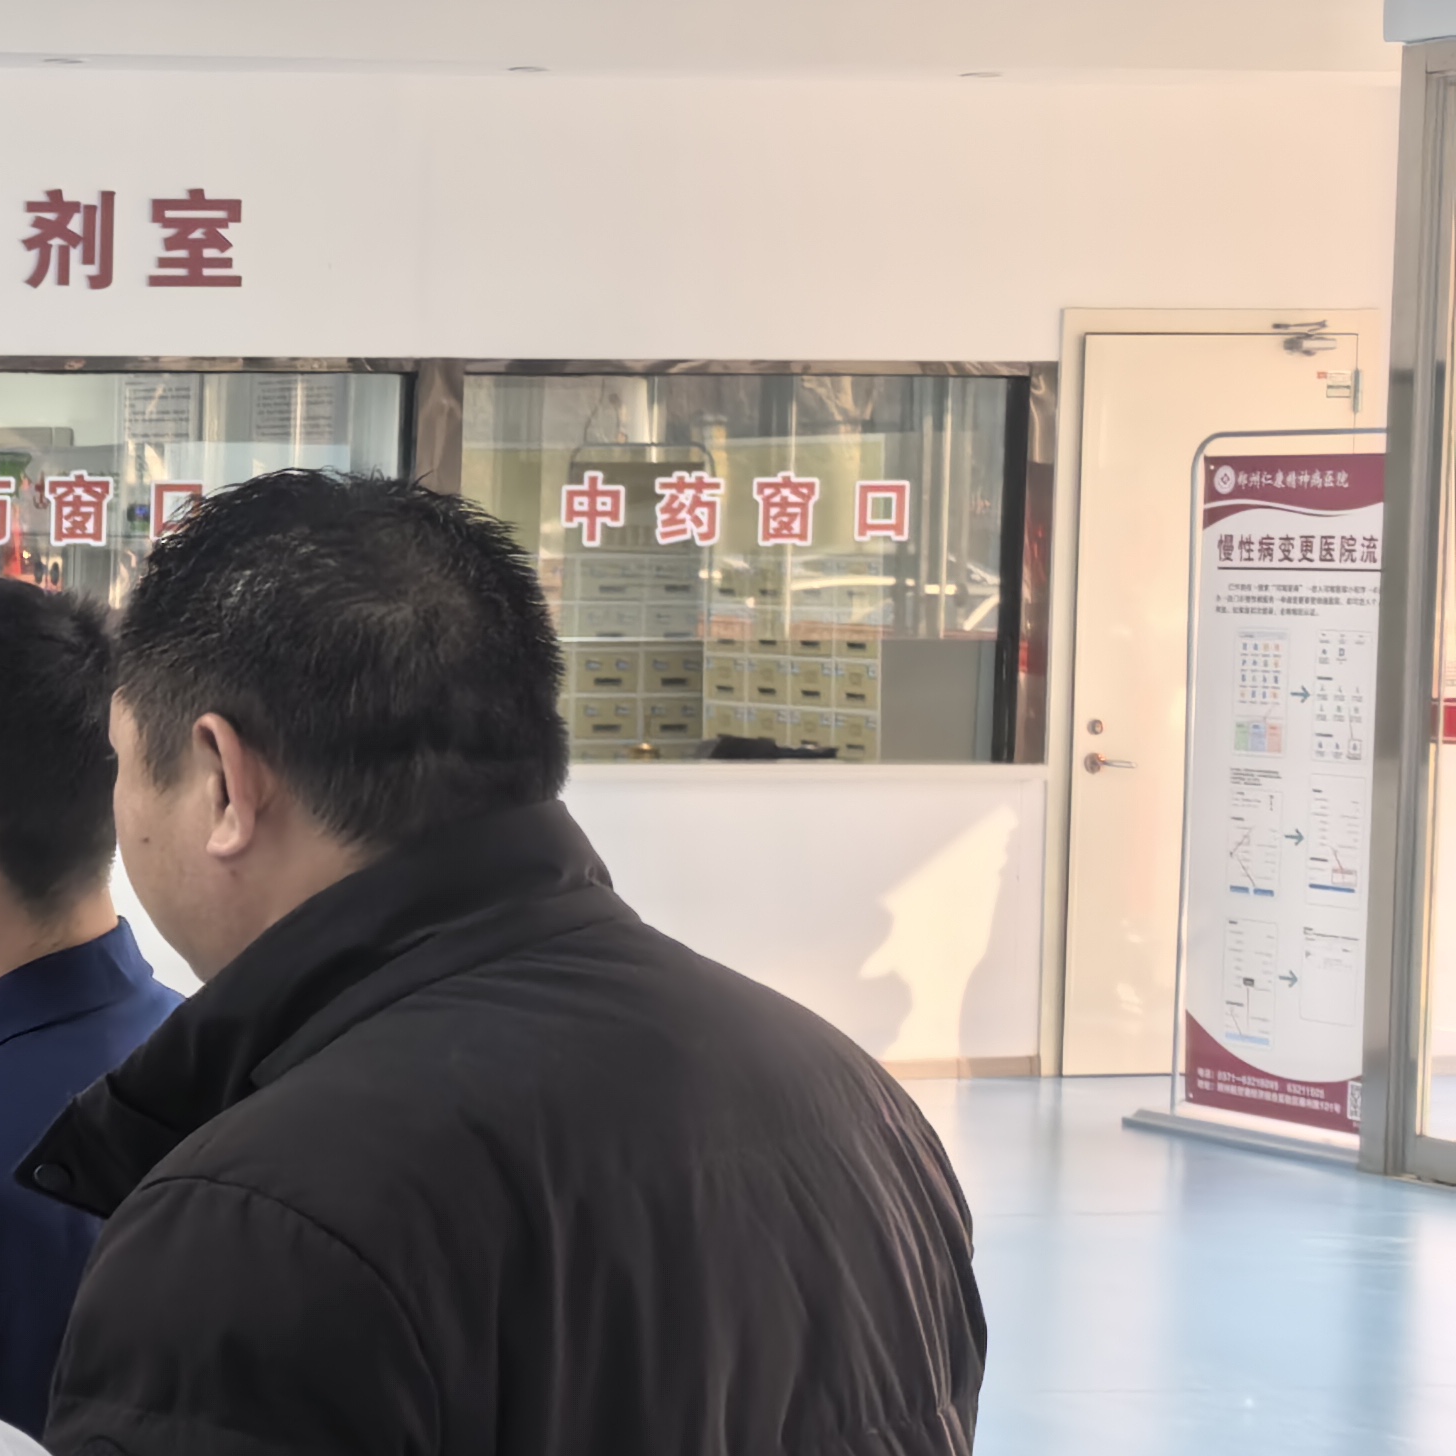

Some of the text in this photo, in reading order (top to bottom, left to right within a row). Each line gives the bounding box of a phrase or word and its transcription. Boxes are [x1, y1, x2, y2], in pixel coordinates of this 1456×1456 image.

[562, 472, 910, 546] 中药窗口
[1217, 534, 1379, 564] 慢性病变更医院流
